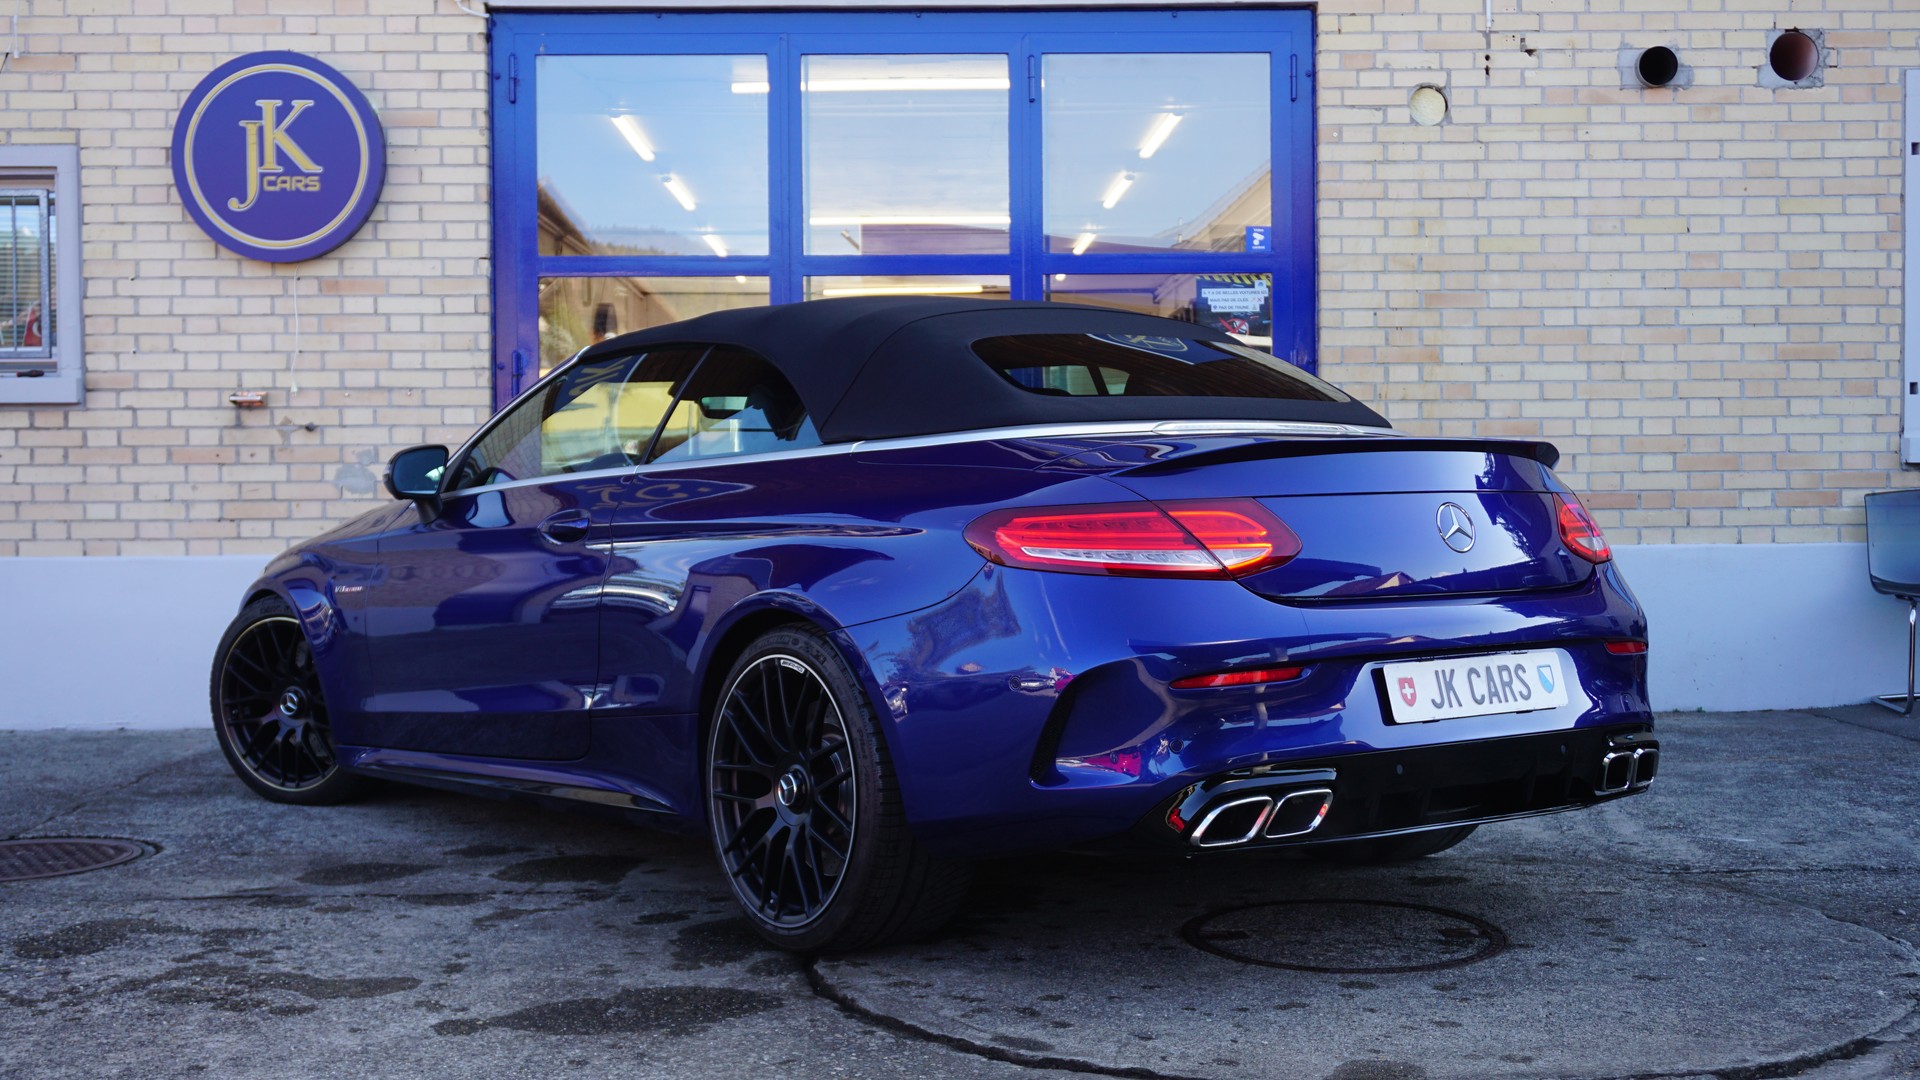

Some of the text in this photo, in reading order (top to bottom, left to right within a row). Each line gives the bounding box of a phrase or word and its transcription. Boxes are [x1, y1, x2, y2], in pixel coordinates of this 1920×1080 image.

[263, 175, 321, 192] CARS
[1431, 663, 1532, 709] JK CARS
